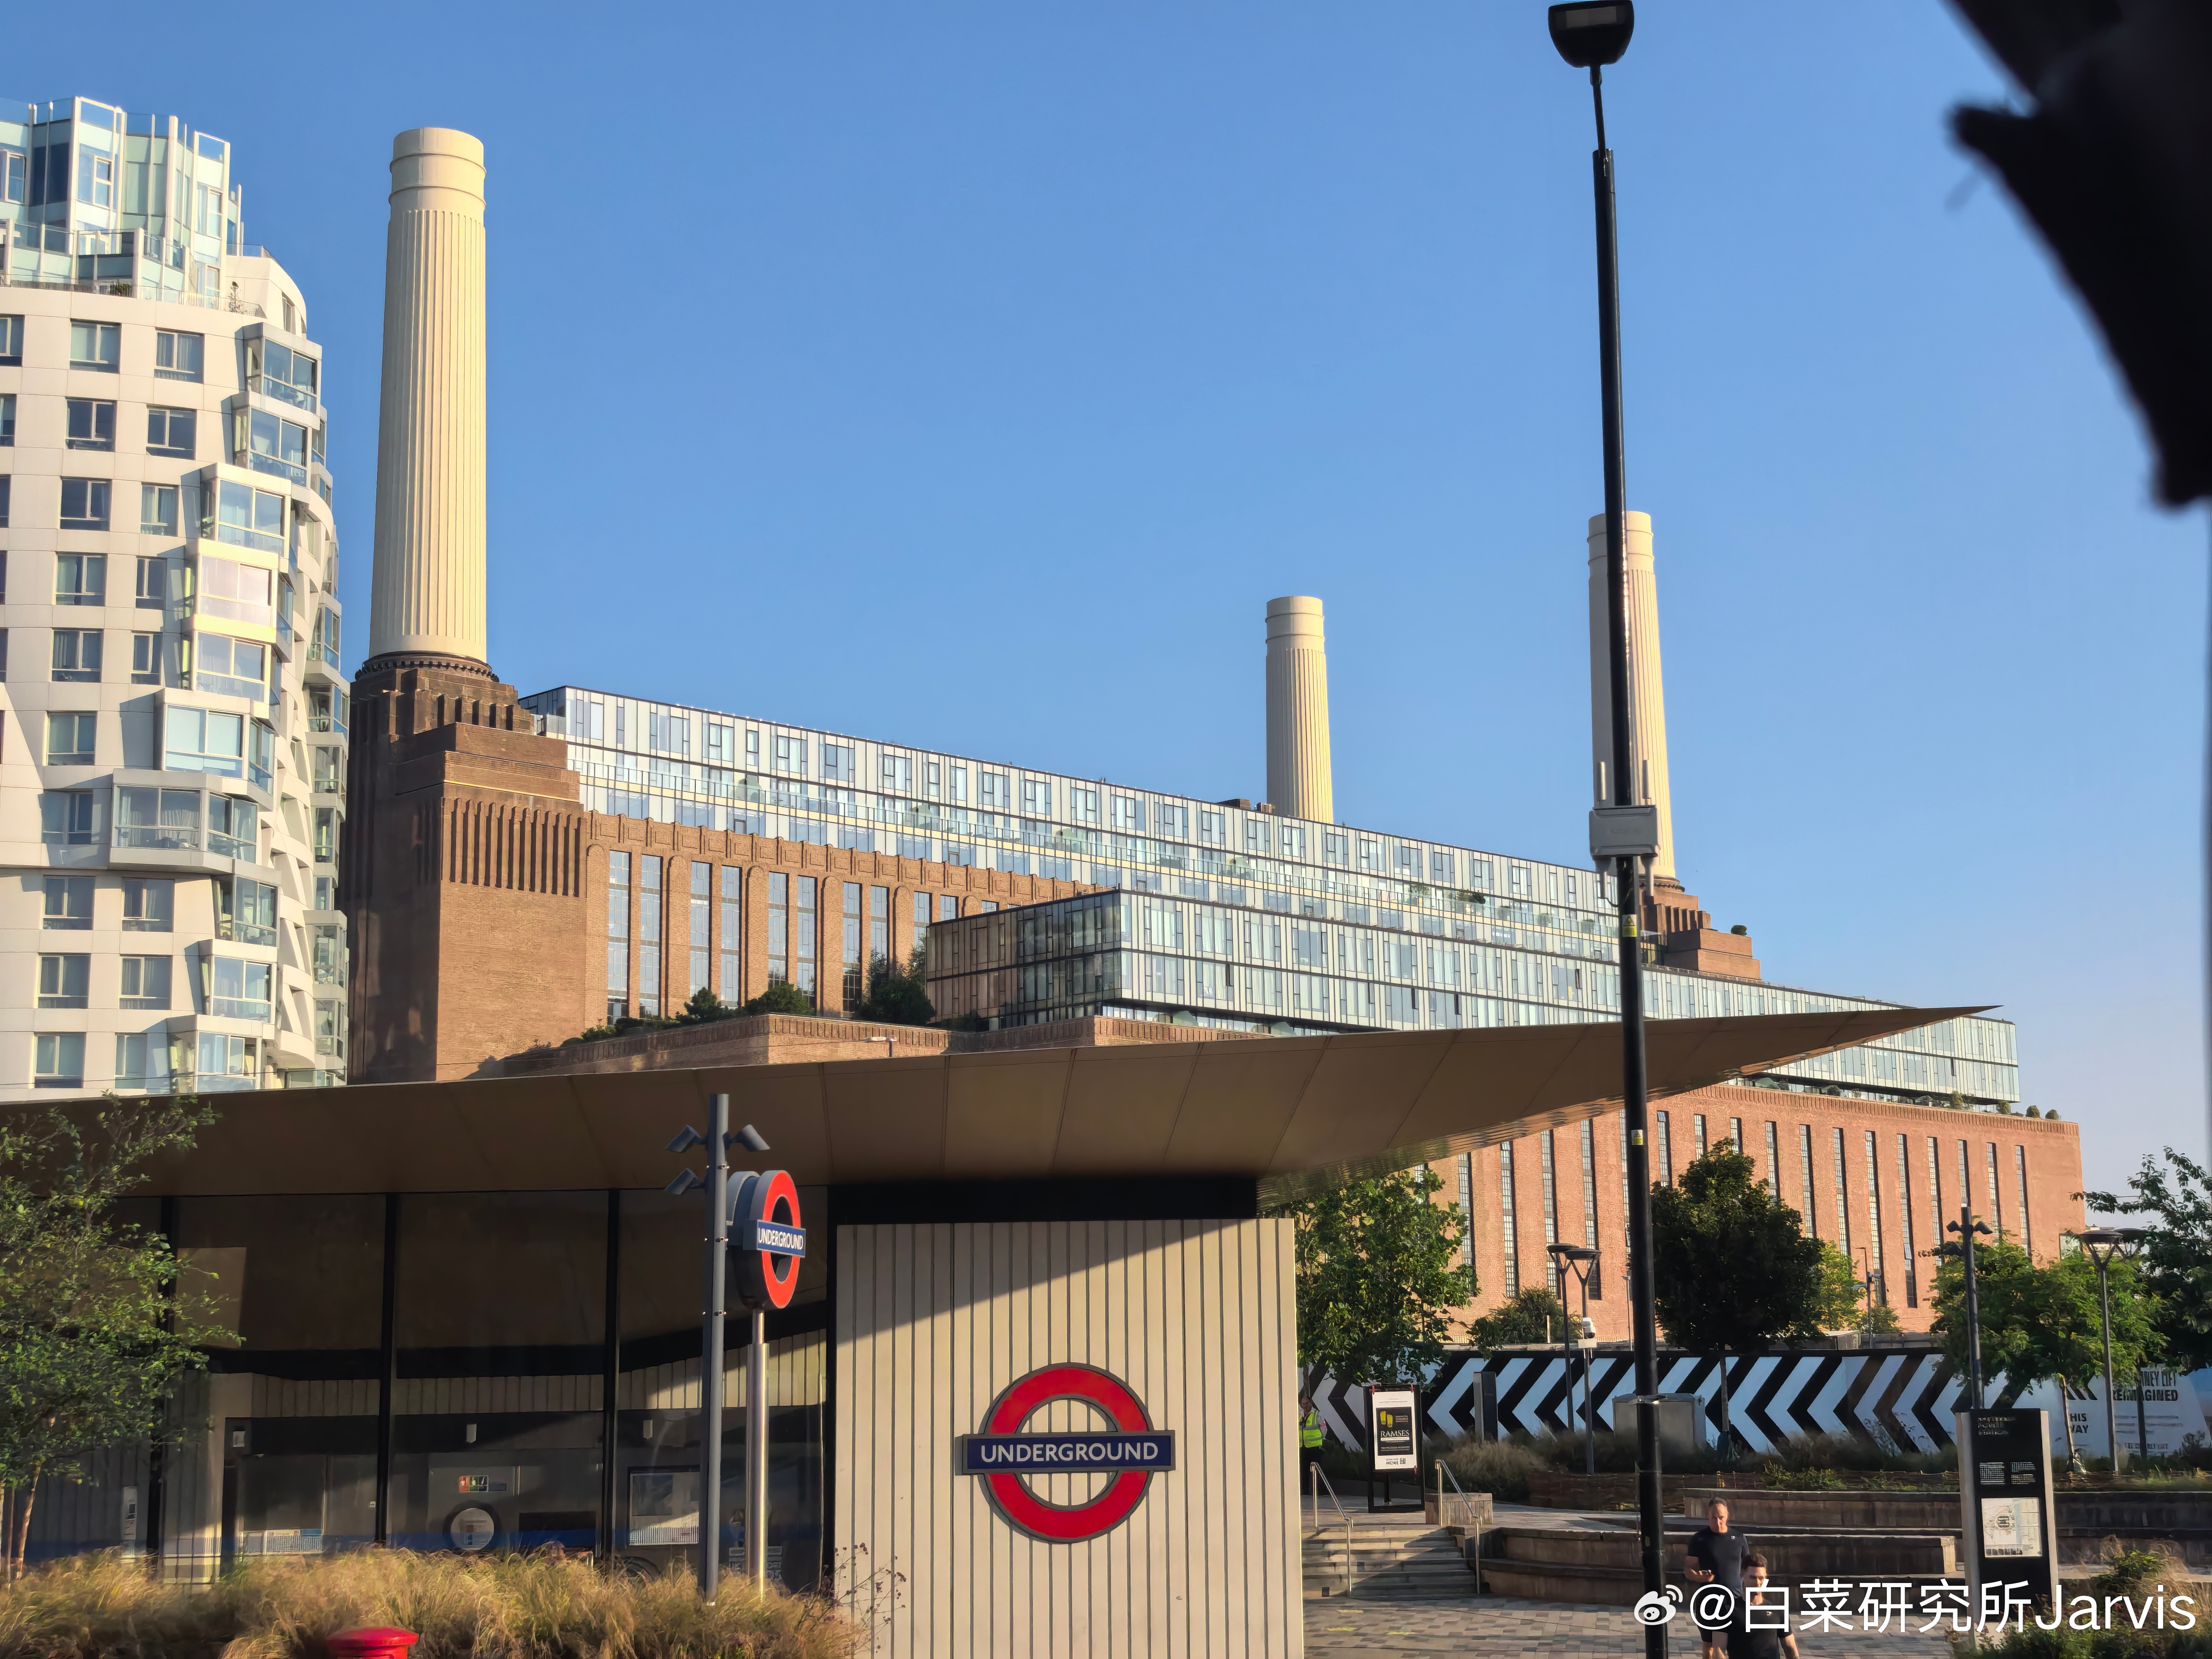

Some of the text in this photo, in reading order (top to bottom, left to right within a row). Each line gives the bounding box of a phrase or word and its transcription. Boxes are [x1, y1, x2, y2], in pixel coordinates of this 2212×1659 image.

[758, 1228, 803, 1250] UNDERGROUND
[2070, 1413, 2087, 1422] HIS
[981, 1442, 1159, 1463] UNDERGROUND
